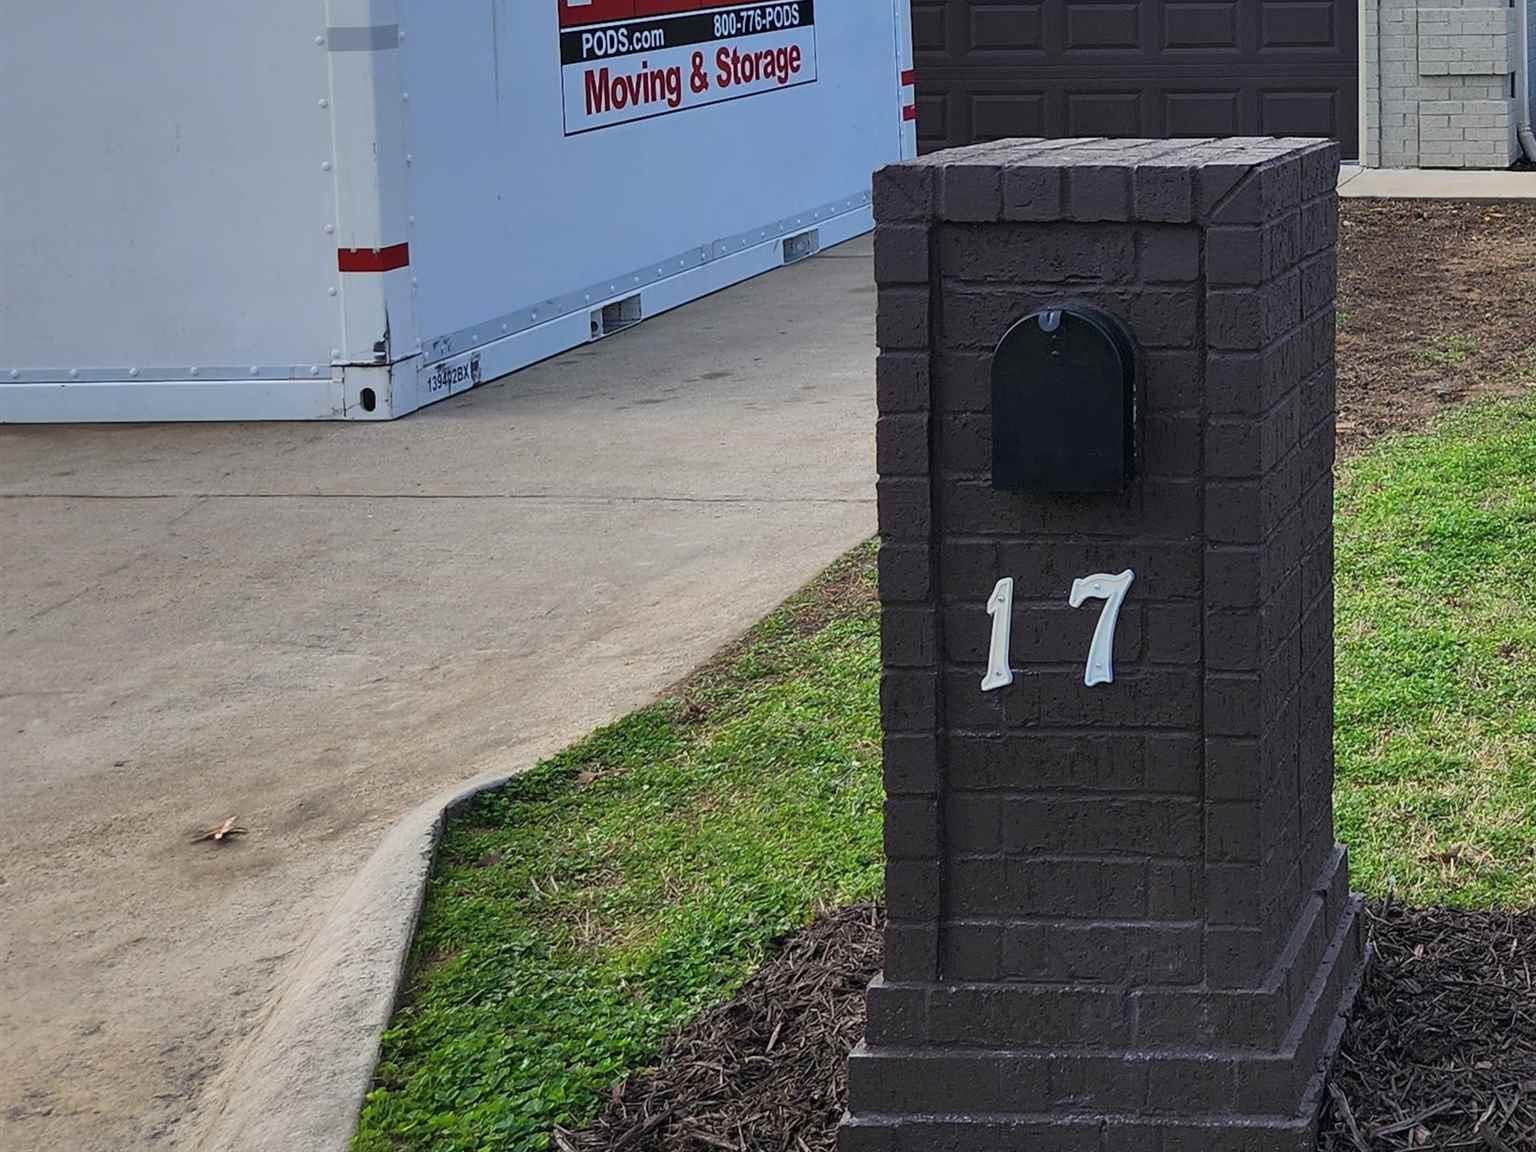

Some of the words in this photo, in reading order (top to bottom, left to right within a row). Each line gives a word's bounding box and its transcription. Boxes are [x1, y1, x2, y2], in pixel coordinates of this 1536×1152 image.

[581, 26, 665, 59] PODS.com
[712, 3, 801, 38] 800-776-PODS
[584, 60, 682, 116] Moving
[689, 50, 709, 94] &
[715, 43, 801, 88] Storage
[980, 568, 1137, 692] 17
